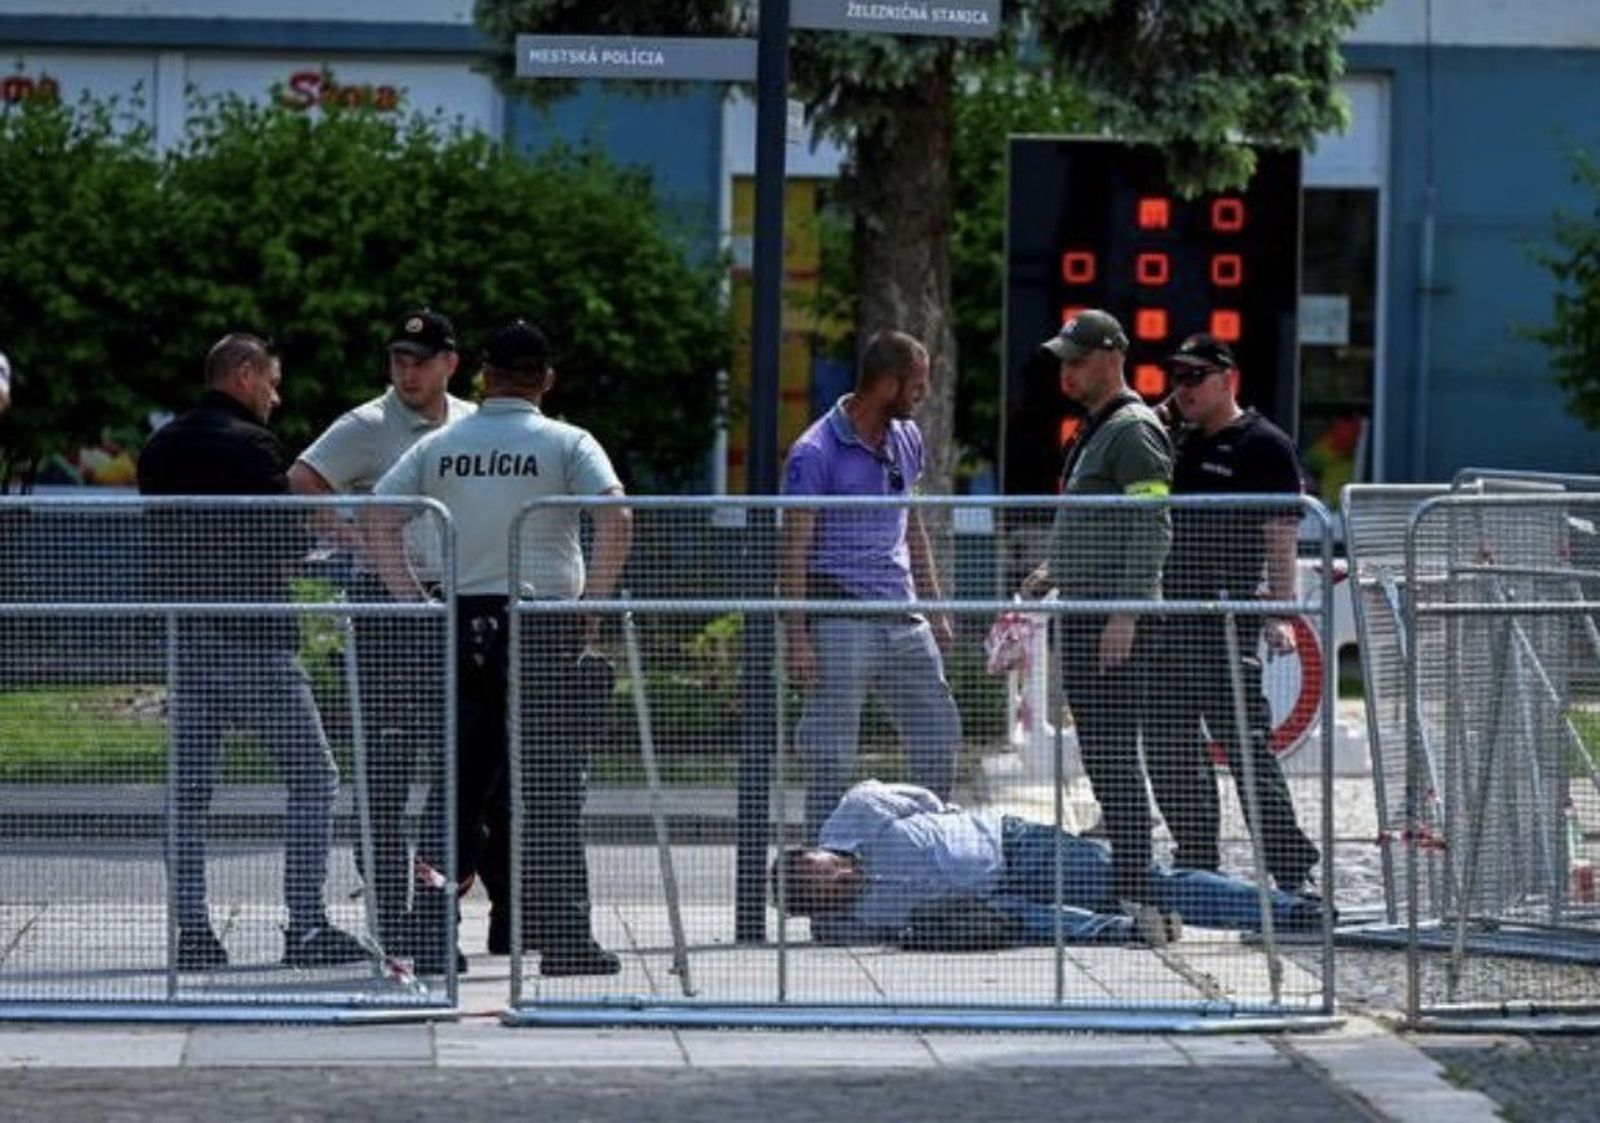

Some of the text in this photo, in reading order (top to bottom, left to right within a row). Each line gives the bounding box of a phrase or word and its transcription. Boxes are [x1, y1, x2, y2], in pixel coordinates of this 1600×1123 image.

[931, 7, 989, 24] STANICA
[529, 46, 664, 65] MESTSKÁ POLÍCIA
[438, 450, 539, 478] POLÍCIA
